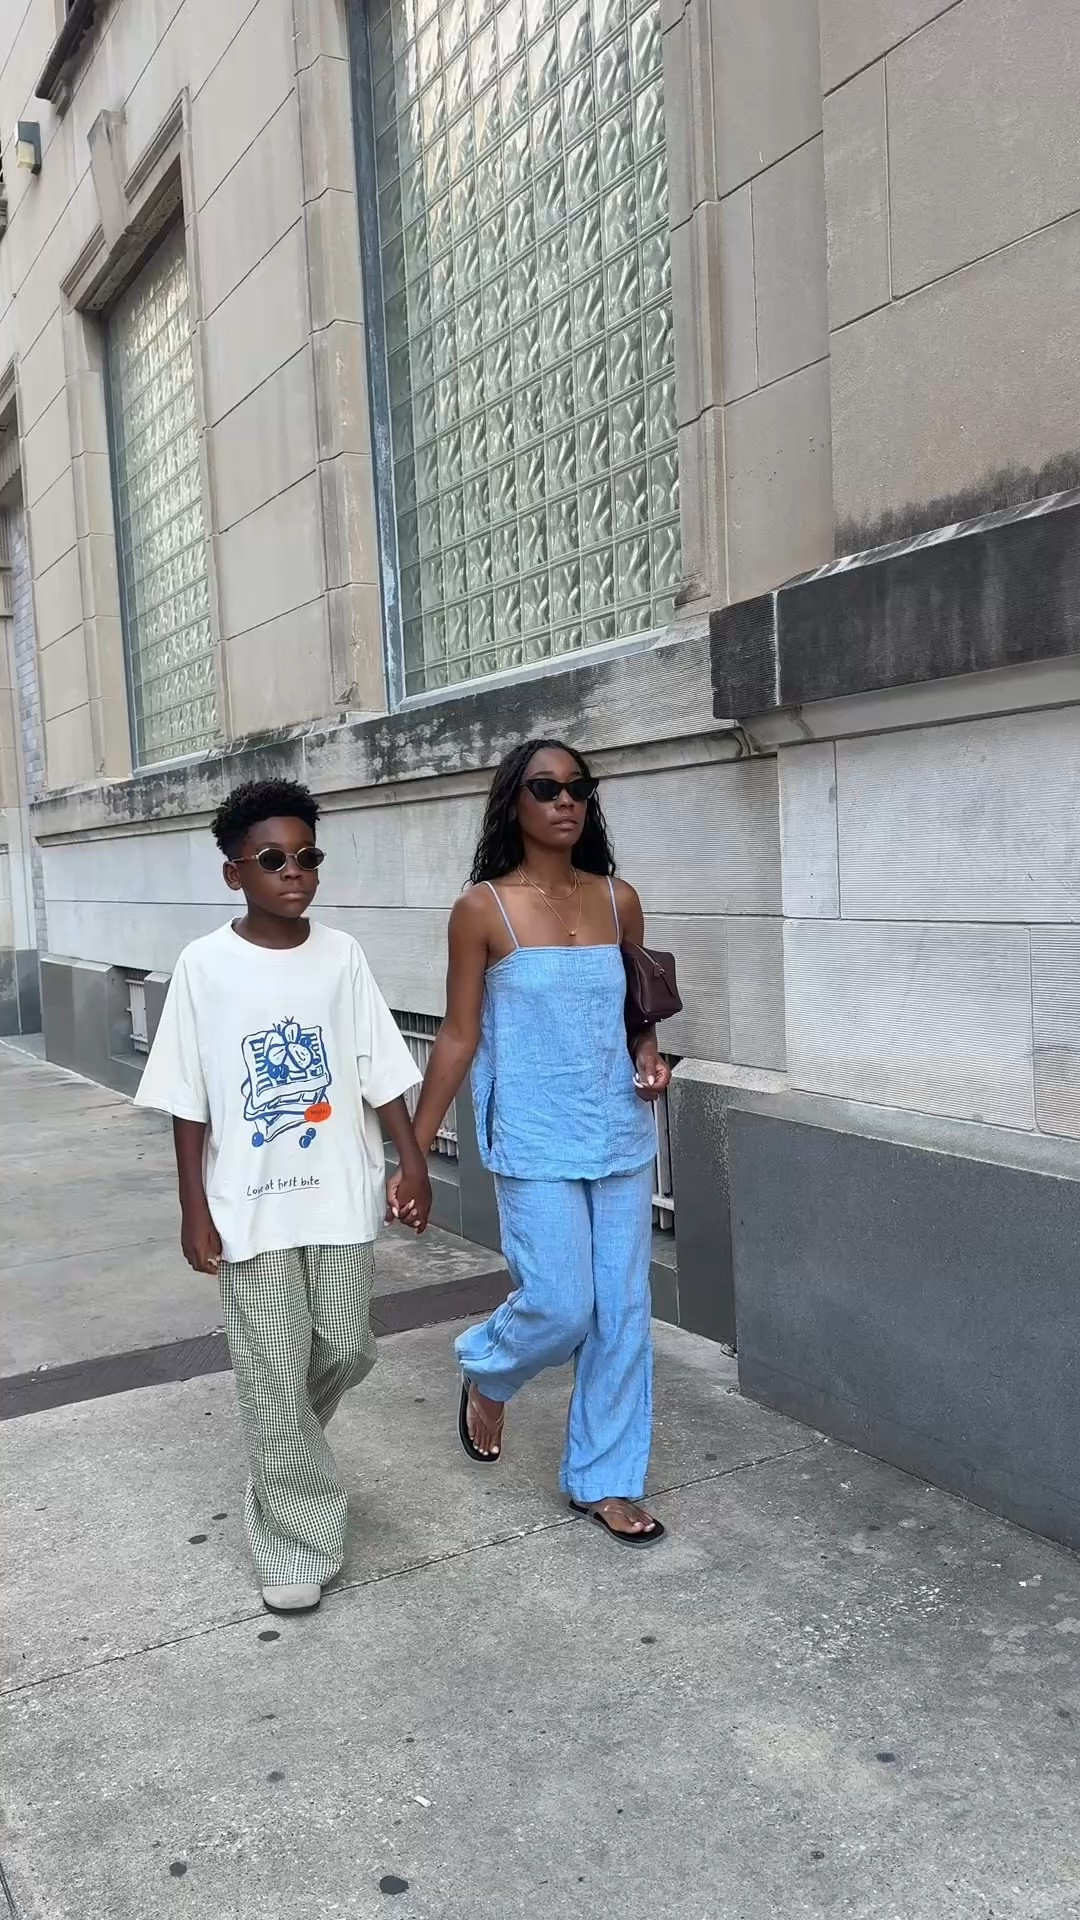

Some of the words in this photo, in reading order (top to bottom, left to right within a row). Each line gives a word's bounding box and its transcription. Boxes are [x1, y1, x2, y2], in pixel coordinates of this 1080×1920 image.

[264, 1179, 274, 1190] at
[278, 1177, 297, 1190] first
[301, 1175, 320, 1186] bite
